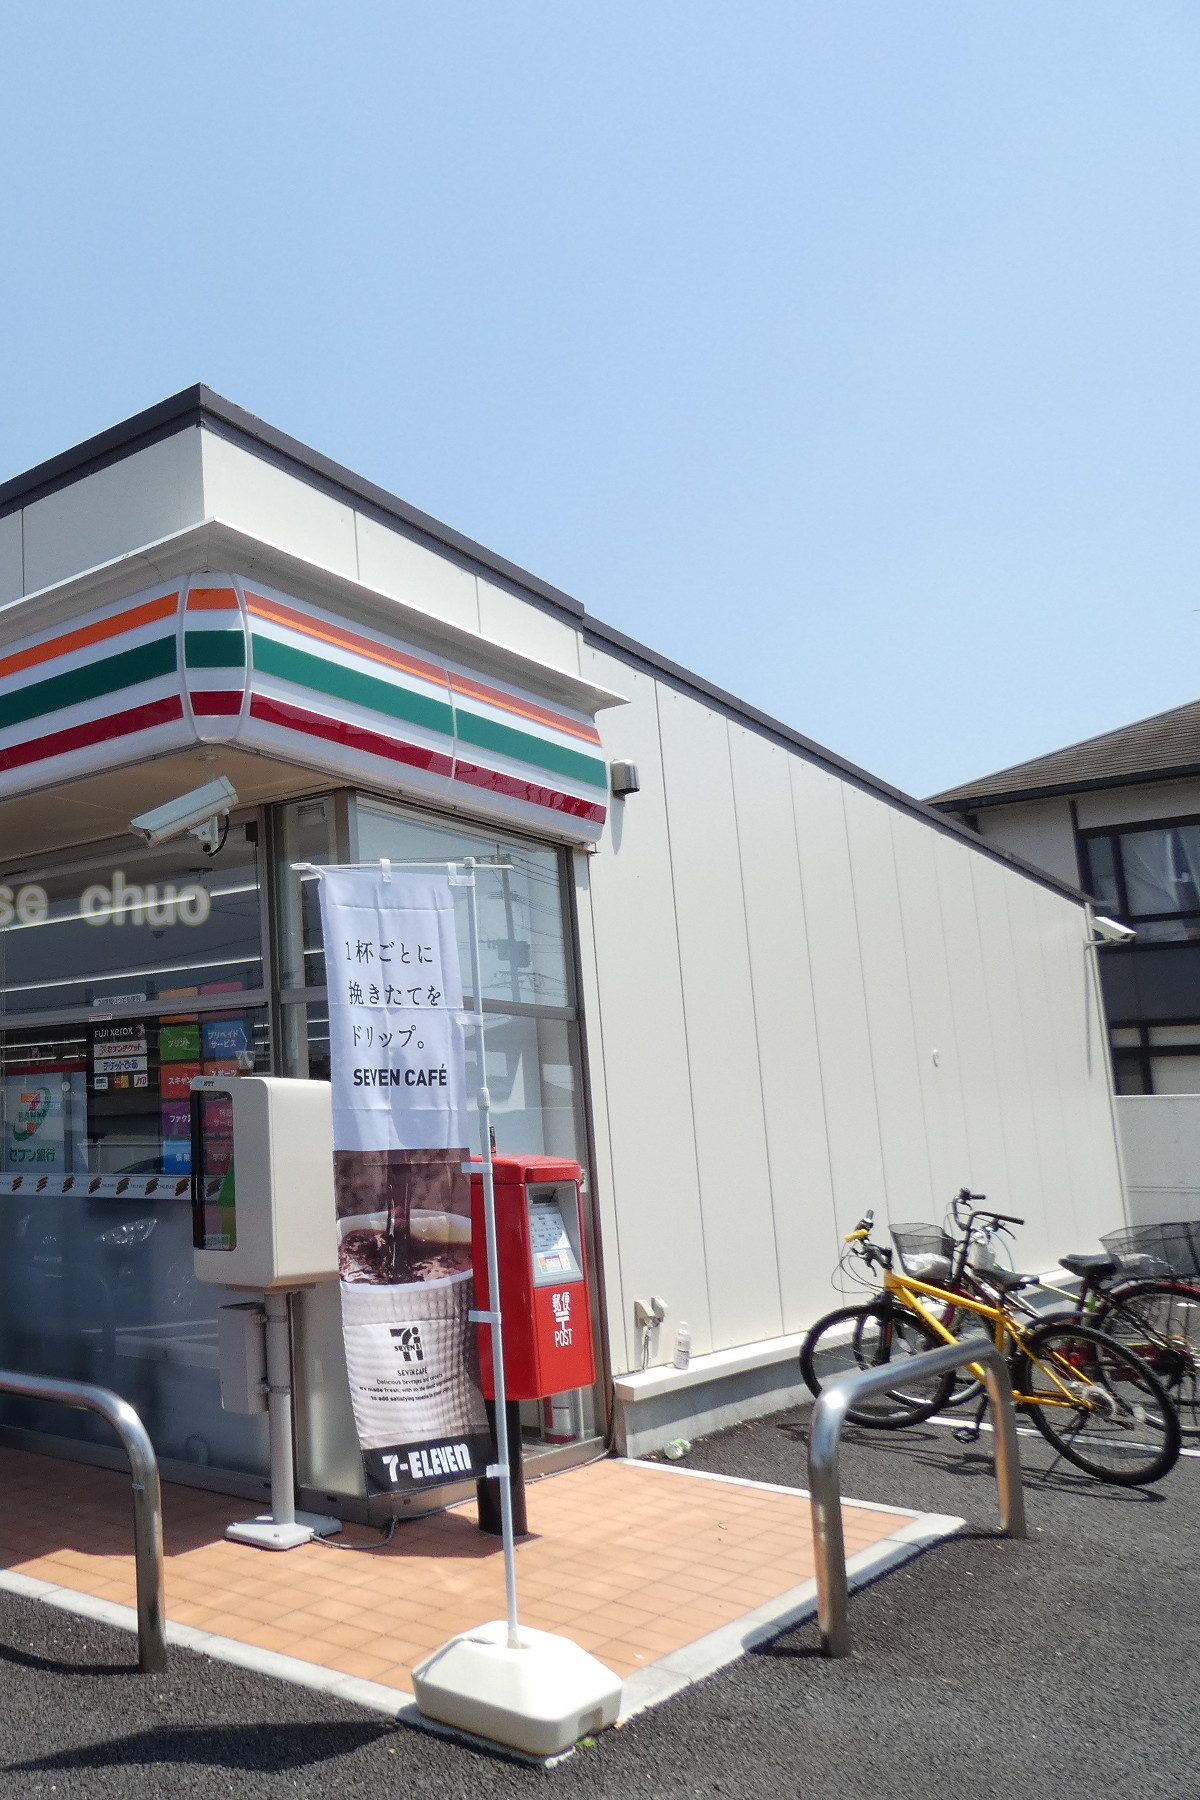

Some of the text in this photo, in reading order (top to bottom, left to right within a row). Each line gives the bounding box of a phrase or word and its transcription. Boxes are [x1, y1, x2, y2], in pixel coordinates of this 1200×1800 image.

[345, 939, 433, 964] 1杯ごとに
[349, 981, 442, 1006] 挽きたてを
[94, 1027, 133, 1038] FUJI xerox
[352, 1024, 425, 1050] ドリップ。
[168, 1037, 191, 1048] プリント
[211, 1040, 237, 1049] サービス
[353, 1063, 448, 1087] SEVEN CAFÉ
[8, 1148, 56, 1162] セブン銀行
[552, 1292, 571, 1313] 郵便
[555, 1329, 573, 1347] POST
